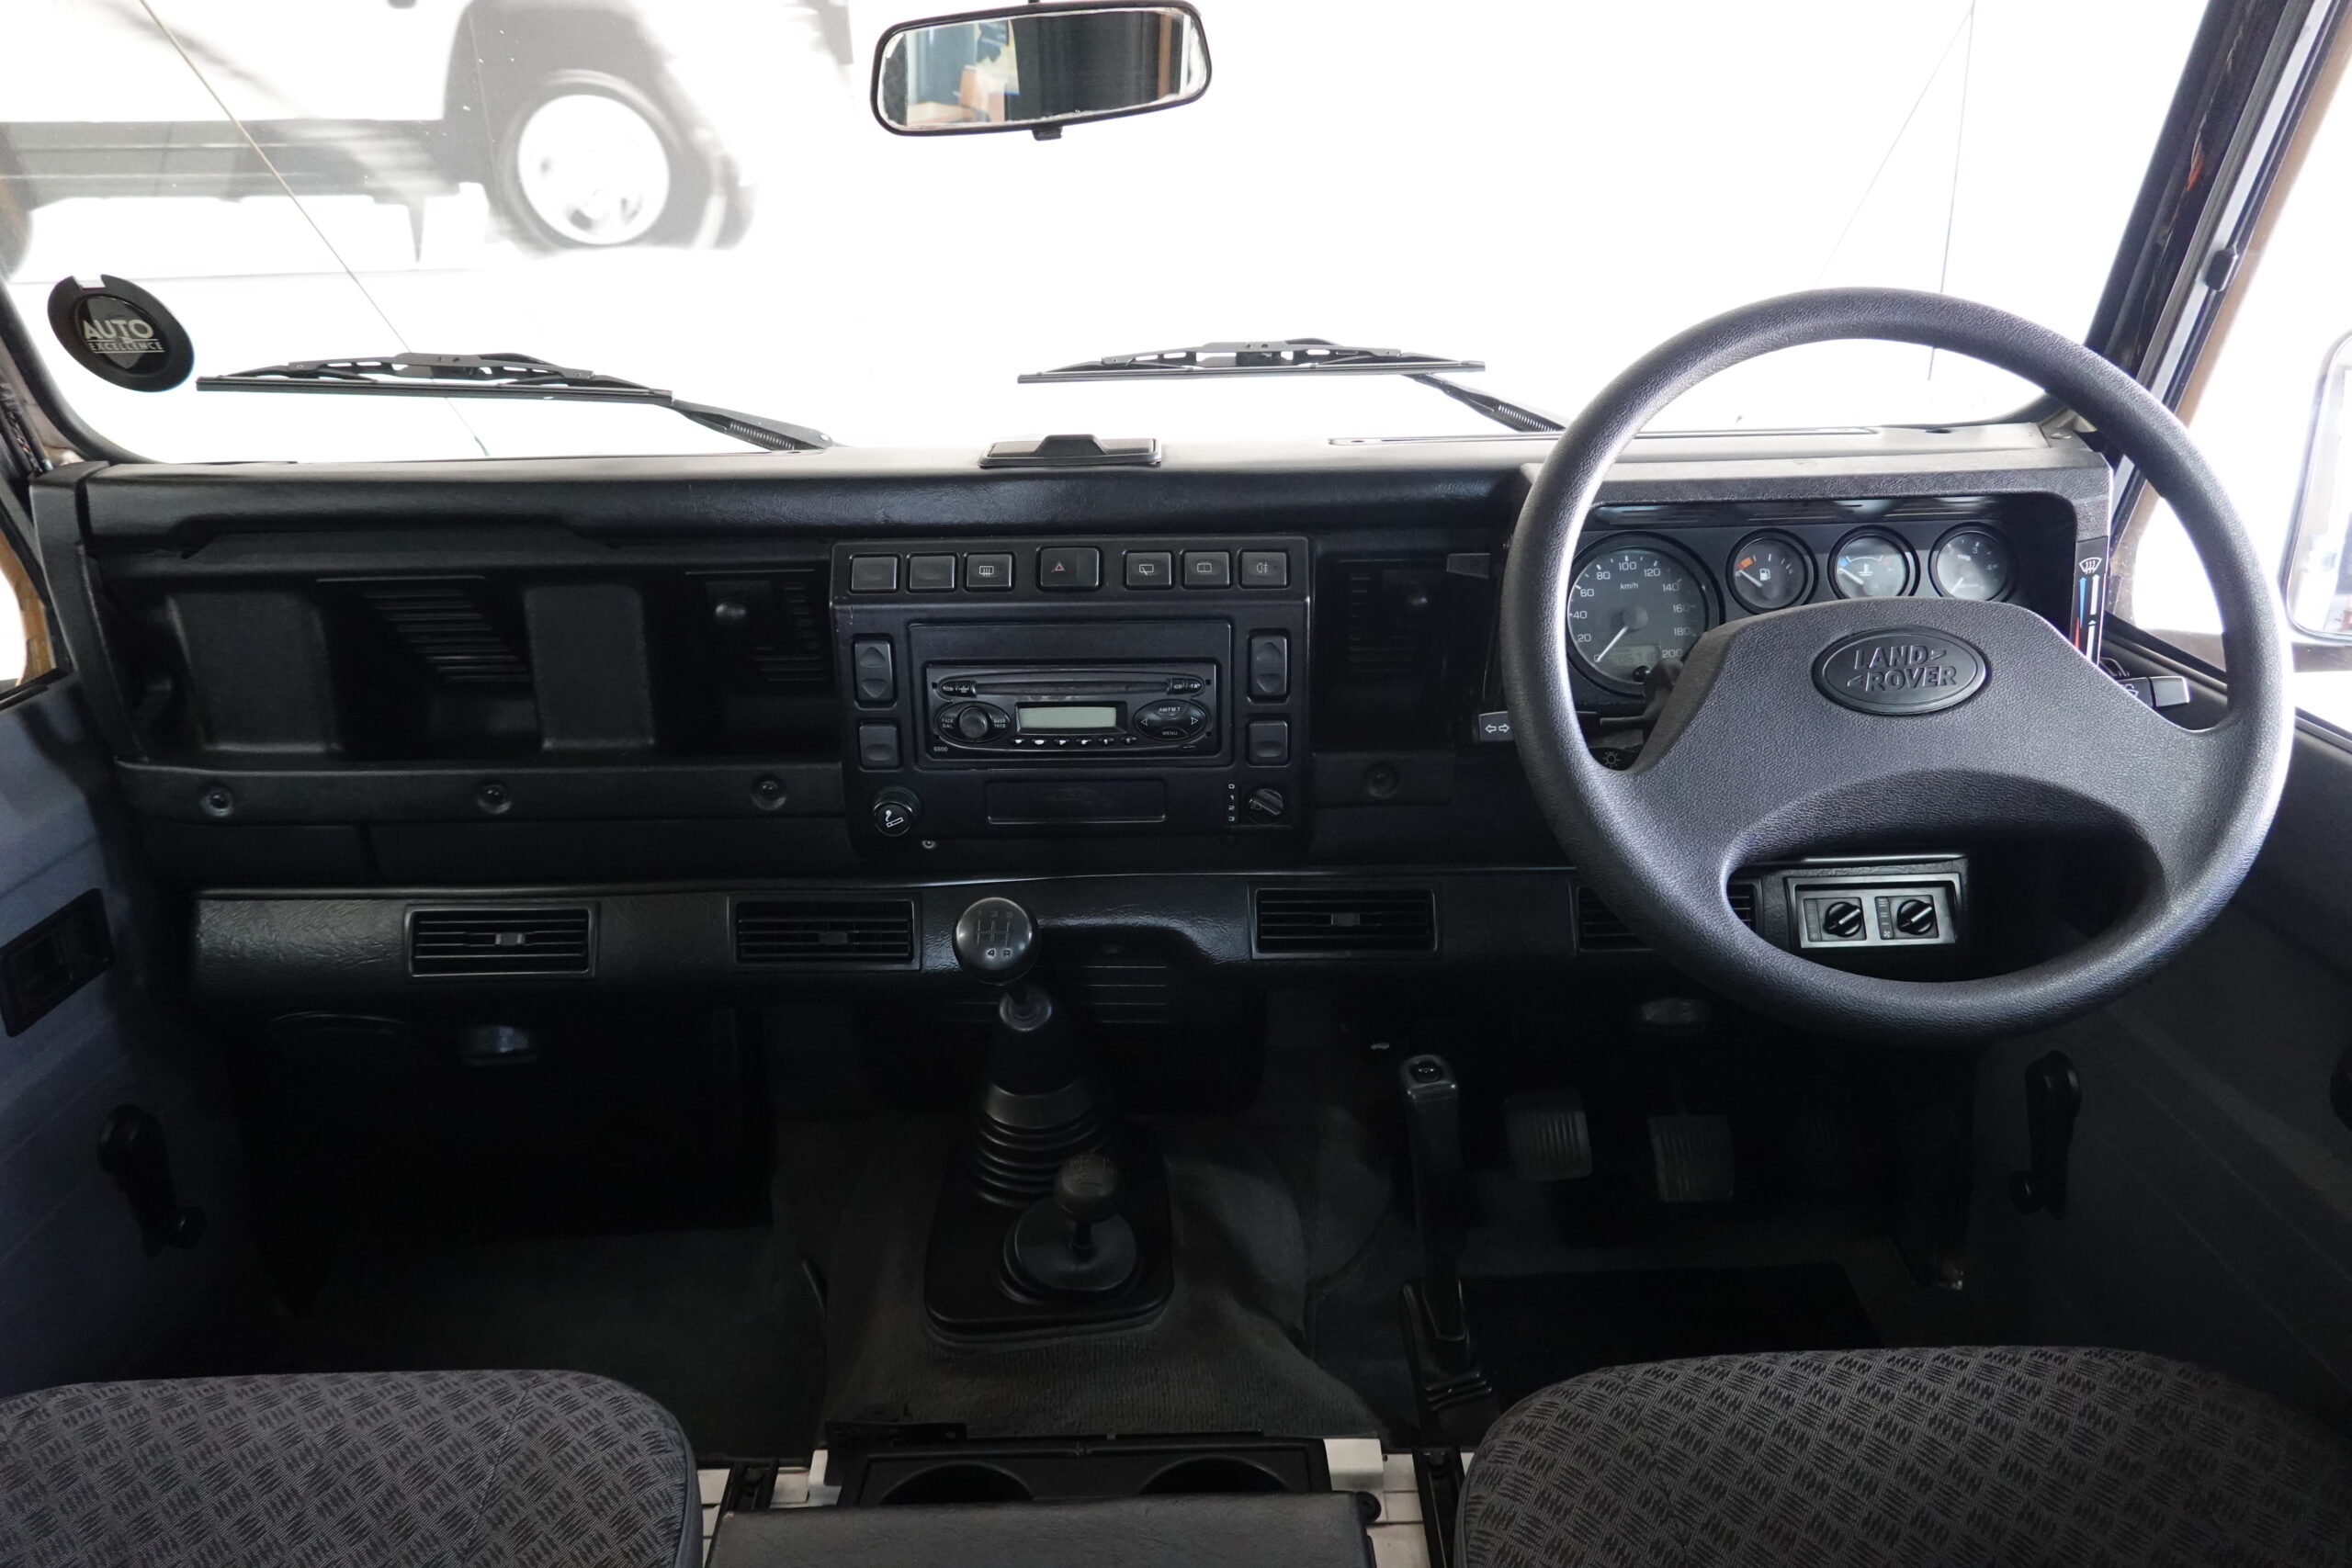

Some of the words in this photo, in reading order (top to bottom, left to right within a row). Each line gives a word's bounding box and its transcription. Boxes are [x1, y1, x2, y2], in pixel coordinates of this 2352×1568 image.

[84, 319, 153, 340] AUTO
[89, 341, 164, 351] EXCELLENCE
[1618, 561, 1637, 570] 100
[1596, 571, 1611, 581] 80
[1644, 568, 1661, 577] 120
[1620, 581, 1639, 590] km/h
[1662, 583, 1679, 592] 140
[1579, 588, 1595, 597] 60
[1672, 604, 1690, 613] 160
[1572, 610, 1588, 619] 40
[1673, 626, 1690, 637] 180
[1577, 633, 1591, 642] 20
[1661, 649, 1683, 659] 200
[1854, 645, 1929, 671] LAND
[1865, 665, 1957, 693] ROVER
